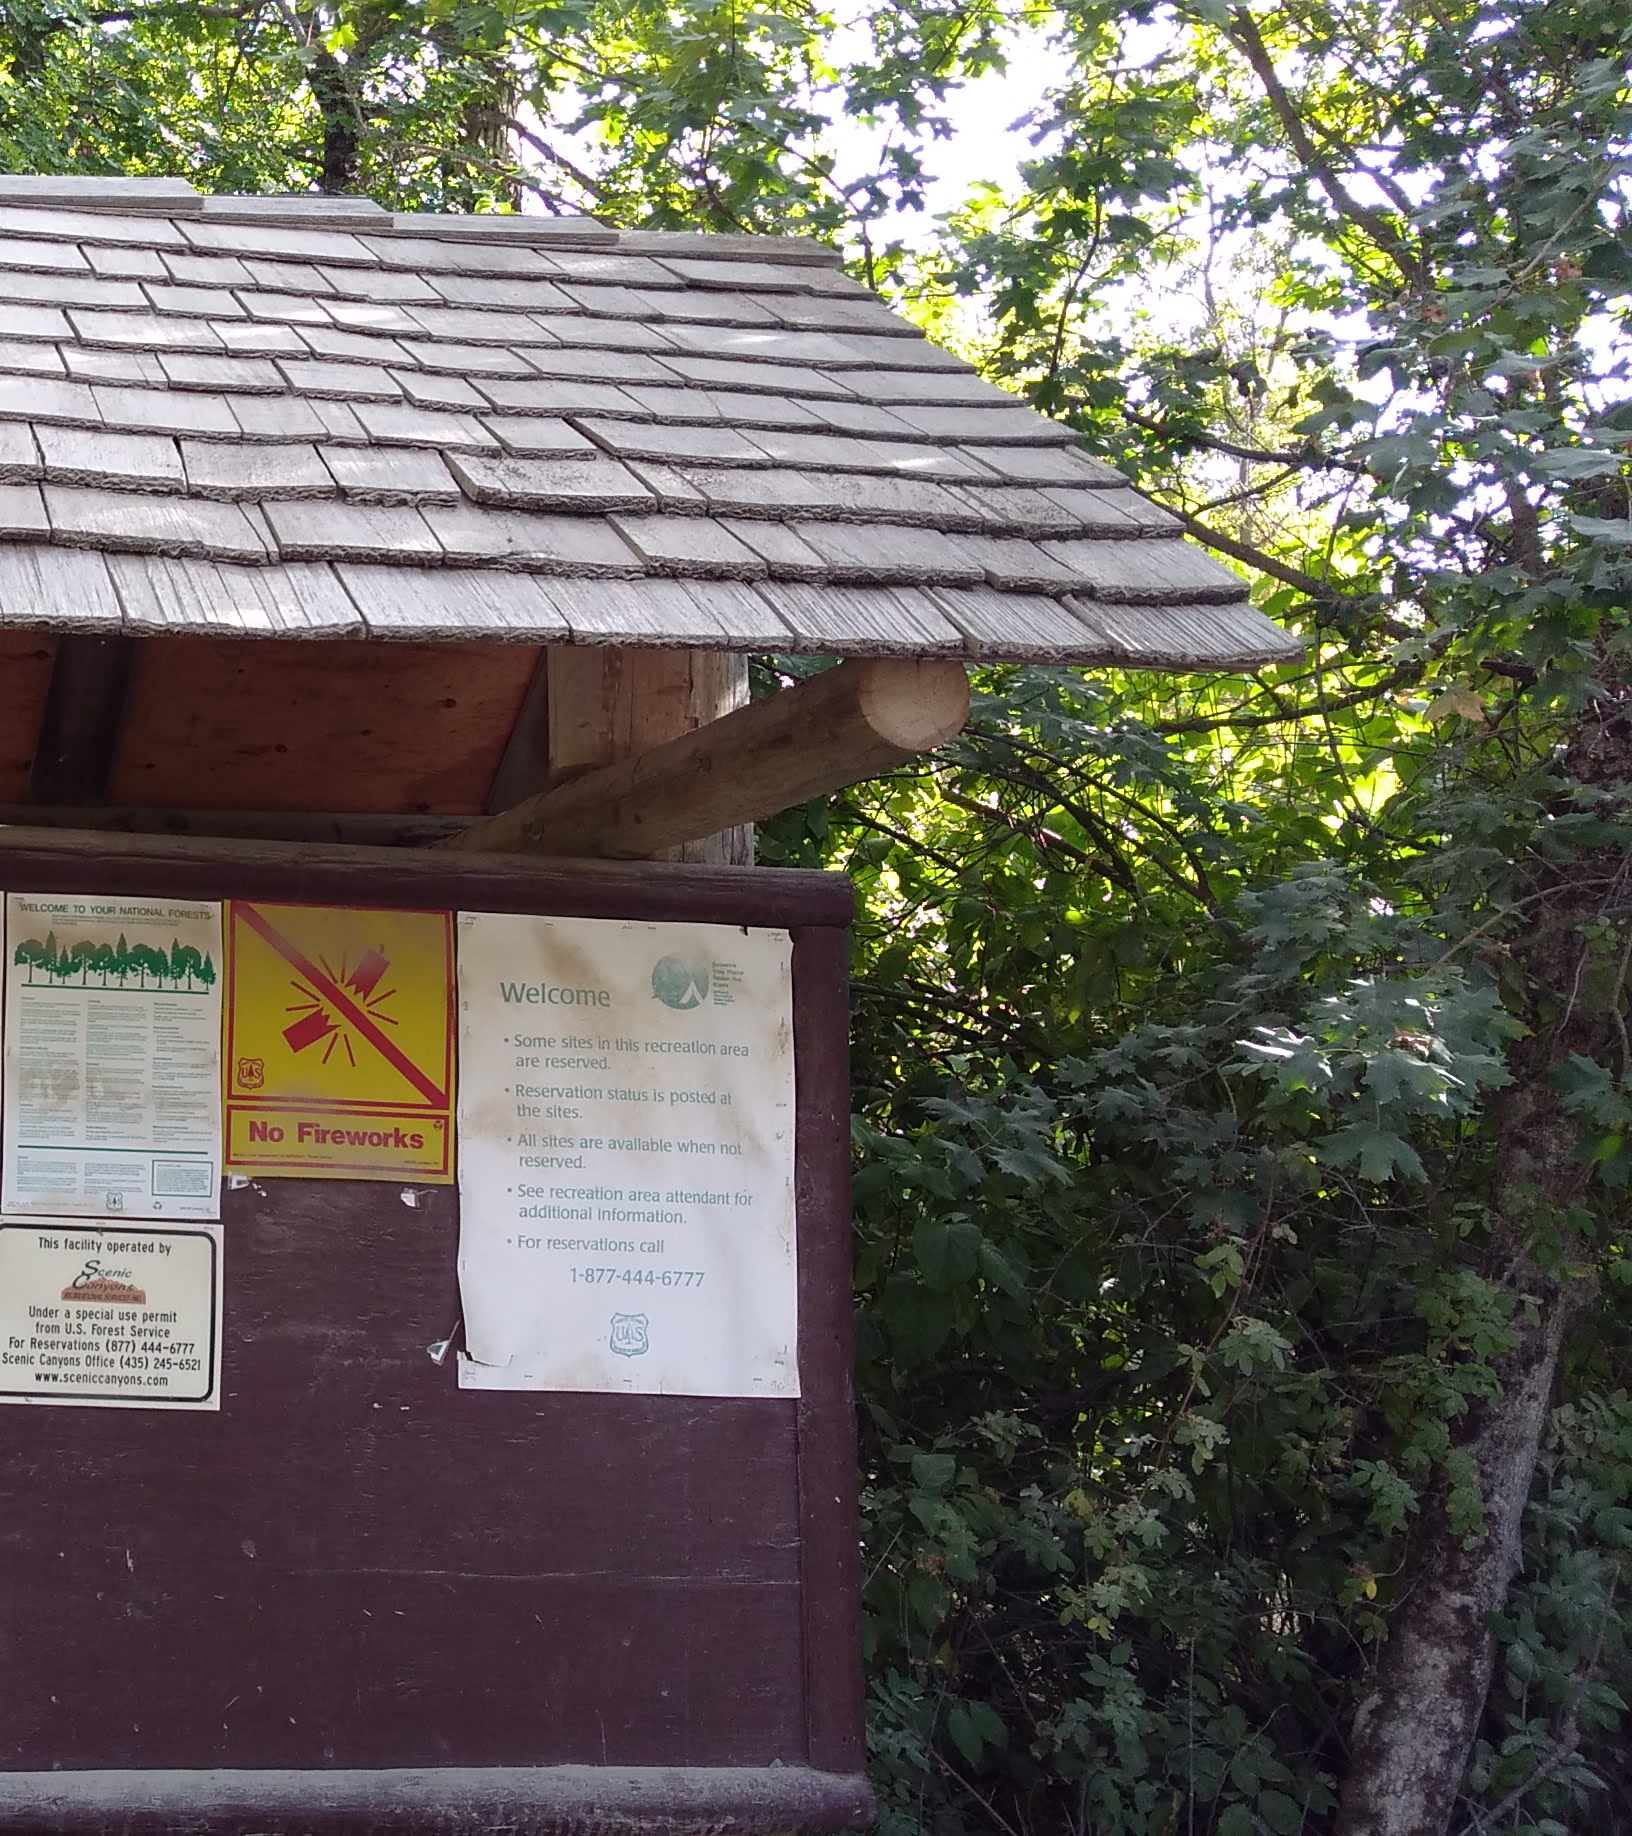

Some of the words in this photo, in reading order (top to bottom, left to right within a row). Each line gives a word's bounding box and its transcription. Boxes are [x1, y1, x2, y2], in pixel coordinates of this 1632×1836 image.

[19, 903, 68, 913] WELCOME
[73, 904, 85, 914] TO
[90, 905, 116, 914] YOUR
[120, 907, 164, 917] NATIONAL
[169, 909, 211, 919] FORESTS
[499, 982, 611, 1007] Welcome
[514, 1034, 556, 1049] Some
[561, 1036, 593, 1050] sites
[597, 1037, 611, 1050] in
[615, 1037, 640, 1052] this
[645, 1039, 716, 1055] recreation
[720, 1043, 749, 1057] area
[515, 1056, 540, 1069] are
[545, 1055, 611, 1070] reserved.
[515, 1083, 602, 1100] Reservation
[607, 1088, 648, 1103] status
[653, 1089, 665, 1103] is
[670, 1090, 716, 1107] posted
[720, 1092, 732, 1106] at
[517, 1104, 541, 1119] the
[545, 1104, 583, 1120] sites.
[249, 1120, 285, 1144] No
[297, 1122, 424, 1150] Fireworks
[518, 1133, 537, 1147] All
[542, 1134, 575, 1148] sites
[579, 1136, 603, 1150] are
[608, 1136, 673, 1153] available
[677, 1139, 716, 1154] when
[720, 1140, 743, 1156] not
[519, 1153, 586, 1169] reserved.
[518, 1184, 544, 1198] See
[550, 1185, 623, 1202] recreation
[628, 1189, 660, 1202] area
[666, 1190, 730, 1205] attendant
[735, 1191, 753, 1206] for
[519, 1205, 593, 1221] additional
[597, 1207, 687, 1224] information.
[38, 1237, 59, 1249] This
[64, 1238, 102, 1253] facility
[107, 1241, 154, 1254] operated
[159, 1243, 171, 1255] by
[518, 1235, 542, 1249] For
[547, 1236, 635, 1253] reservations
[640, 1240, 665, 1254] call
[569, 1268, 705, 1288] 1-877-444-6777
[28, 1306, 59, 1319] Under
[64, 1310, 71, 1319] a
[75, 1308, 114, 1322] special
[118, 1312, 137, 1322] use
[142, 1311, 177, 1323] permit
[35, 1322, 61, 1335] from
[65, 1324, 87, 1335] U.S.
[91, 1324, 125, 1336] Forest
[130, 1325, 170, 1338] Service
[8, 1336, 25, 1349] For
[30, 1338, 100, 1351] Reservations
[106, 1340, 136, 1354] (877)
[141, 1342, 195, 1354] 444-6777
[2, 1353, 35, 1365] Scenic
[39, 1354, 80, 1368] Canyons
[85, 1355, 115, 1369] Office
[120, 1357, 149, 1370] (435)
[153, 1358, 201, 1371] 245-6521
[34, 1371, 168, 1388] www.sceniccanyons.com
